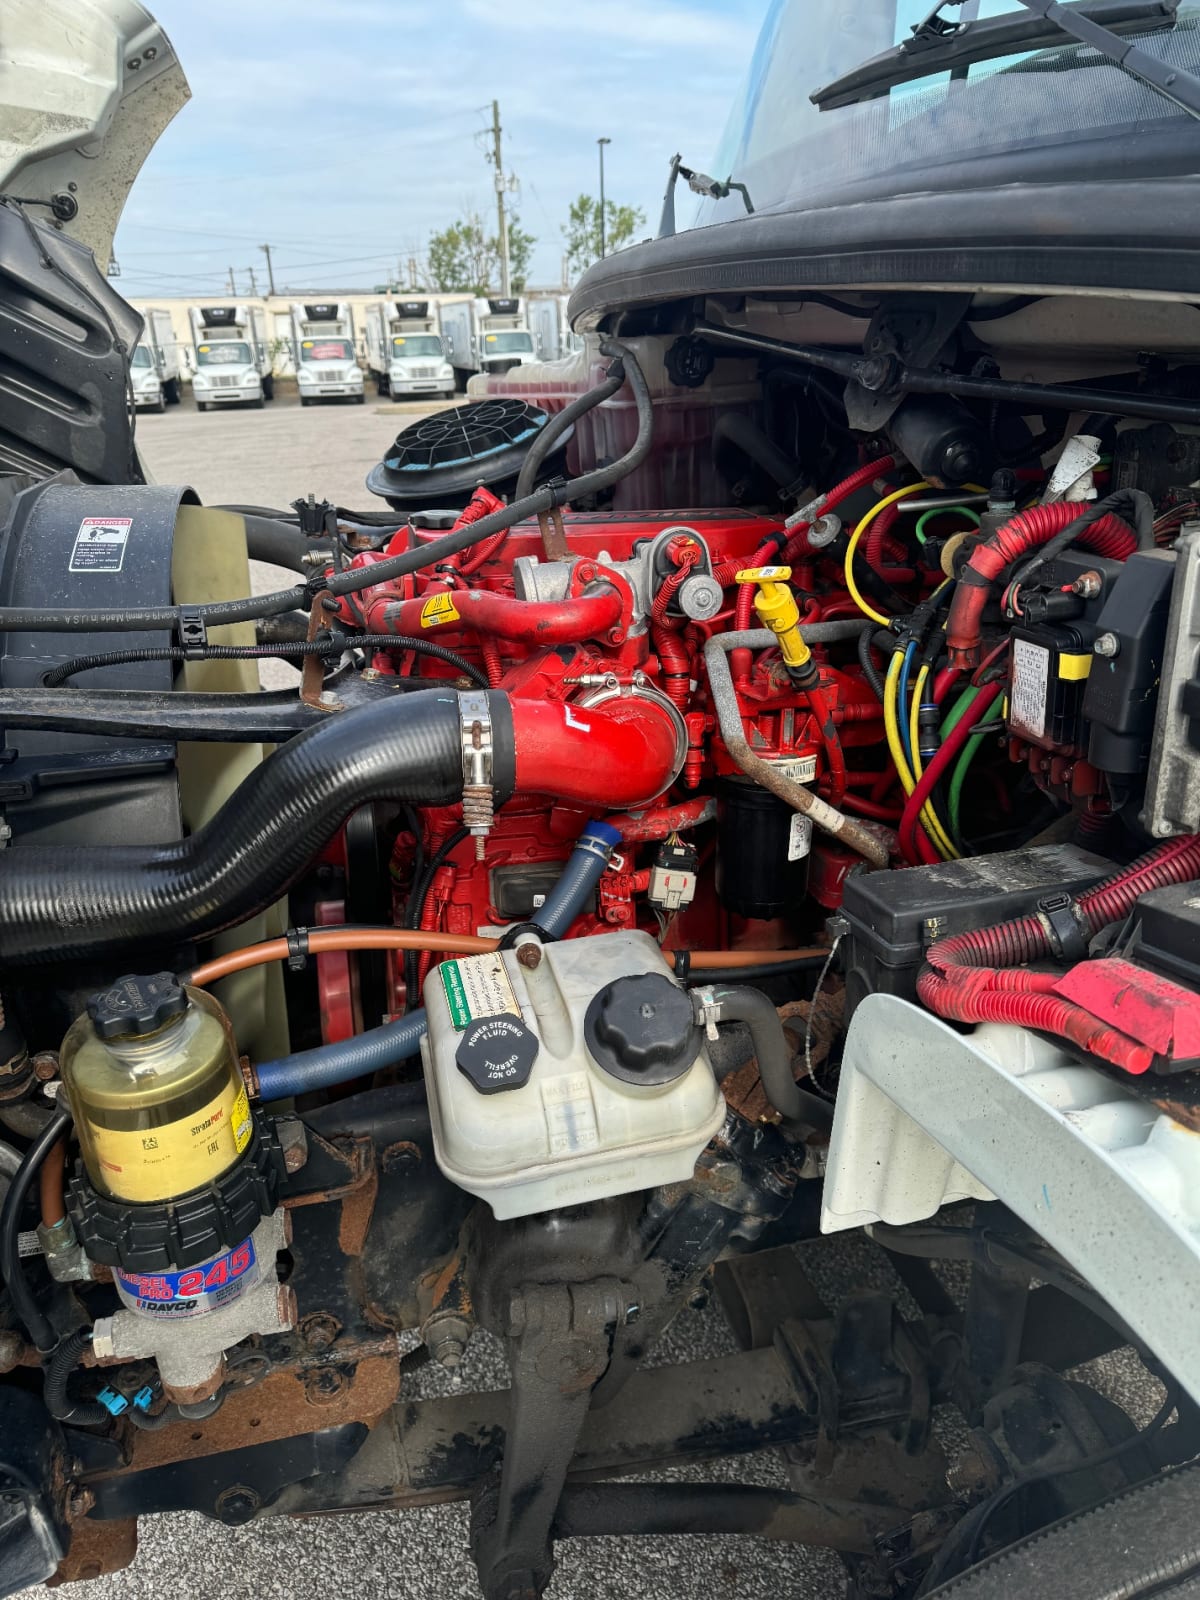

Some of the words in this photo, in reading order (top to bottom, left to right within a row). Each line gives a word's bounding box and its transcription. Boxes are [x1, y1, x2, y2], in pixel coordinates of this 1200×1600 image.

[231, 601, 248, 611] SAE
[63, 613, 89, 624] U.S.A.
[101, 612, 124, 623] Made
[468, 1024, 488, 1047] POWER
[489, 1021, 524, 1038] STEERING
[483, 1030, 507, 1041] FLUID
[484, 1054, 519, 1071] OVERFILL
[504, 1067, 517, 1077] DO
[117, 1267, 171, 1289] DIESEL
[177, 1240, 251, 1298] 245
[138, 1287, 174, 1300] PRO
[147, 1300, 198, 1312] DAVCO
